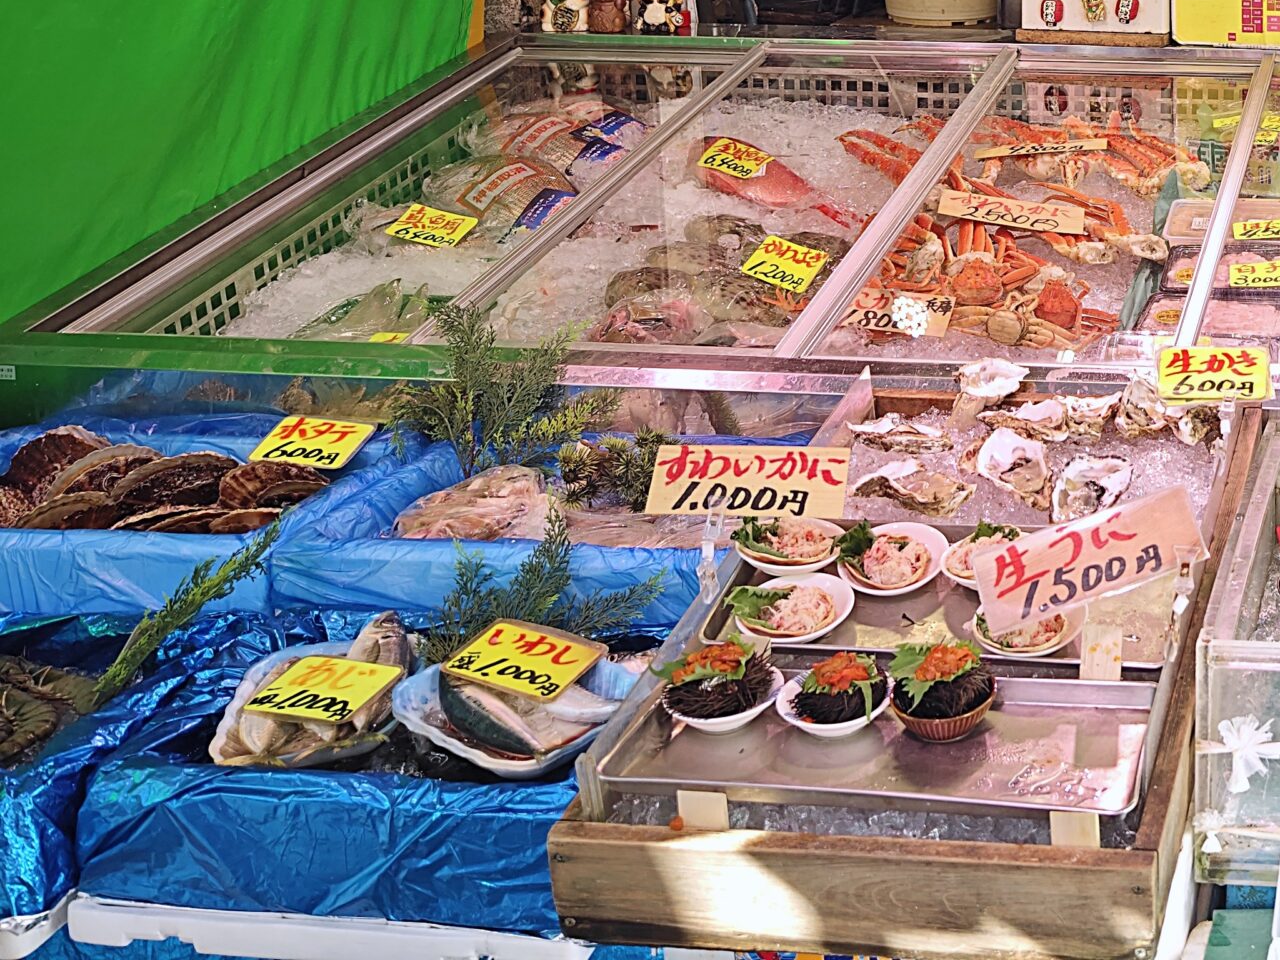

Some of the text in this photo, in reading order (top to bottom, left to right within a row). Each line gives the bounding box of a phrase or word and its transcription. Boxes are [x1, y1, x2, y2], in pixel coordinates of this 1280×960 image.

[925, 297, 954, 317] 兵庫
[1164, 348, 1259, 377] 生かき
[1171, 375, 1255, 398] 600円
[271, 416, 359, 445] ホタテ
[261, 441, 341, 466] 600円
[993, 512, 1140, 599] 生うに
[487, 628, 580, 666] いわし
[287, 661, 379, 690] あじ
